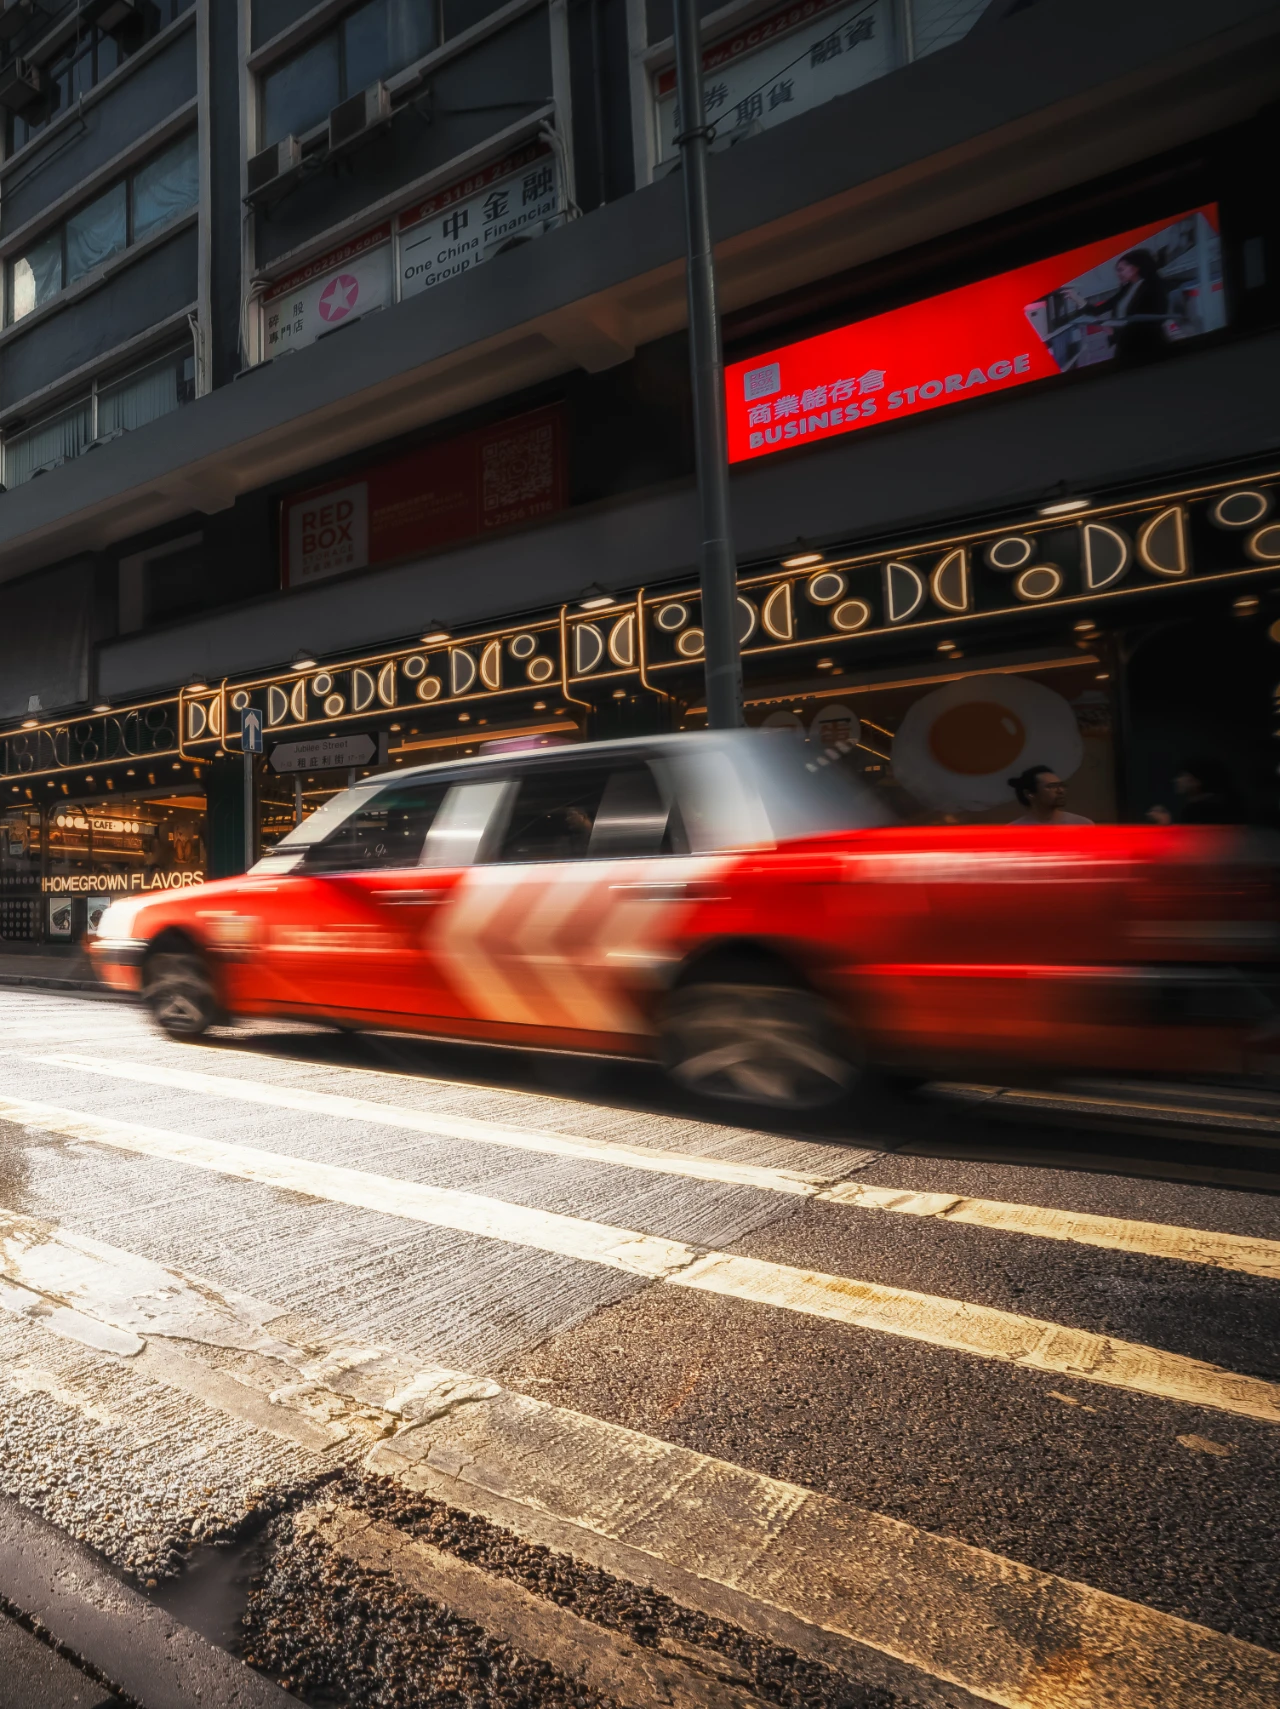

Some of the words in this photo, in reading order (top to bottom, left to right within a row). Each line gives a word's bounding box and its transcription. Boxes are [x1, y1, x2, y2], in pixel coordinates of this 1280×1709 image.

[810, 15, 876, 68] 融資
[736, 79, 795, 126] 期貨
[443, 175, 484, 206] 3188
[492, 148, 537, 180] 2299
[405, 167, 554, 251] 一中金融
[404, 259, 432, 279] One
[436, 236, 479, 264] China
[484, 199, 556, 241] Financial
[425, 259, 470, 287] Group
[268, 318, 304, 344] 專門店
[748, 368, 886, 428] 商業儲存倉
[749, 397, 877, 450] BUSINESS
[888, 353, 1031, 410] STORAGE
[302, 499, 353, 534] RED
[495, 509, 525, 526] 2556
[302, 521, 353, 555] BOX
[294, 743, 320, 753] Jubilee
[322, 740, 348, 750] Street
[297, 754, 344, 768] 租庇利街
[94, 820, 113, 830] CAFE
[43, 873, 128, 893] HOMEGROWN
[131, 871, 205, 890] FLAVORS
